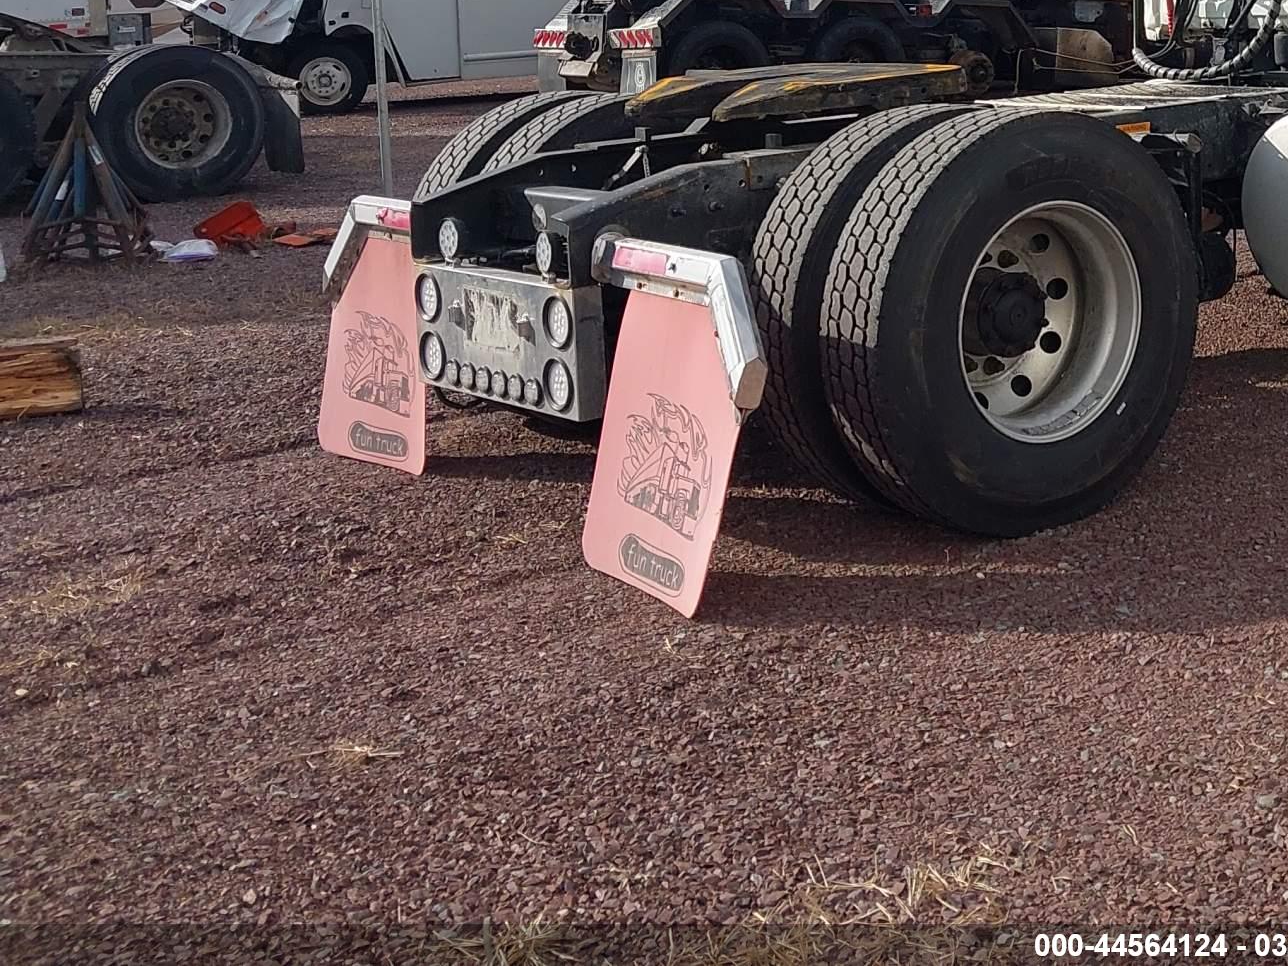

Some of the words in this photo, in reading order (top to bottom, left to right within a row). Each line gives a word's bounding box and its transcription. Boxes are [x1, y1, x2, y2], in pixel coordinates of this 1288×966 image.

[355, 428, 373, 450] fun
[375, 433, 403, 456] truck
[626, 543, 647, 571] fun
[650, 556, 679, 589] truck
